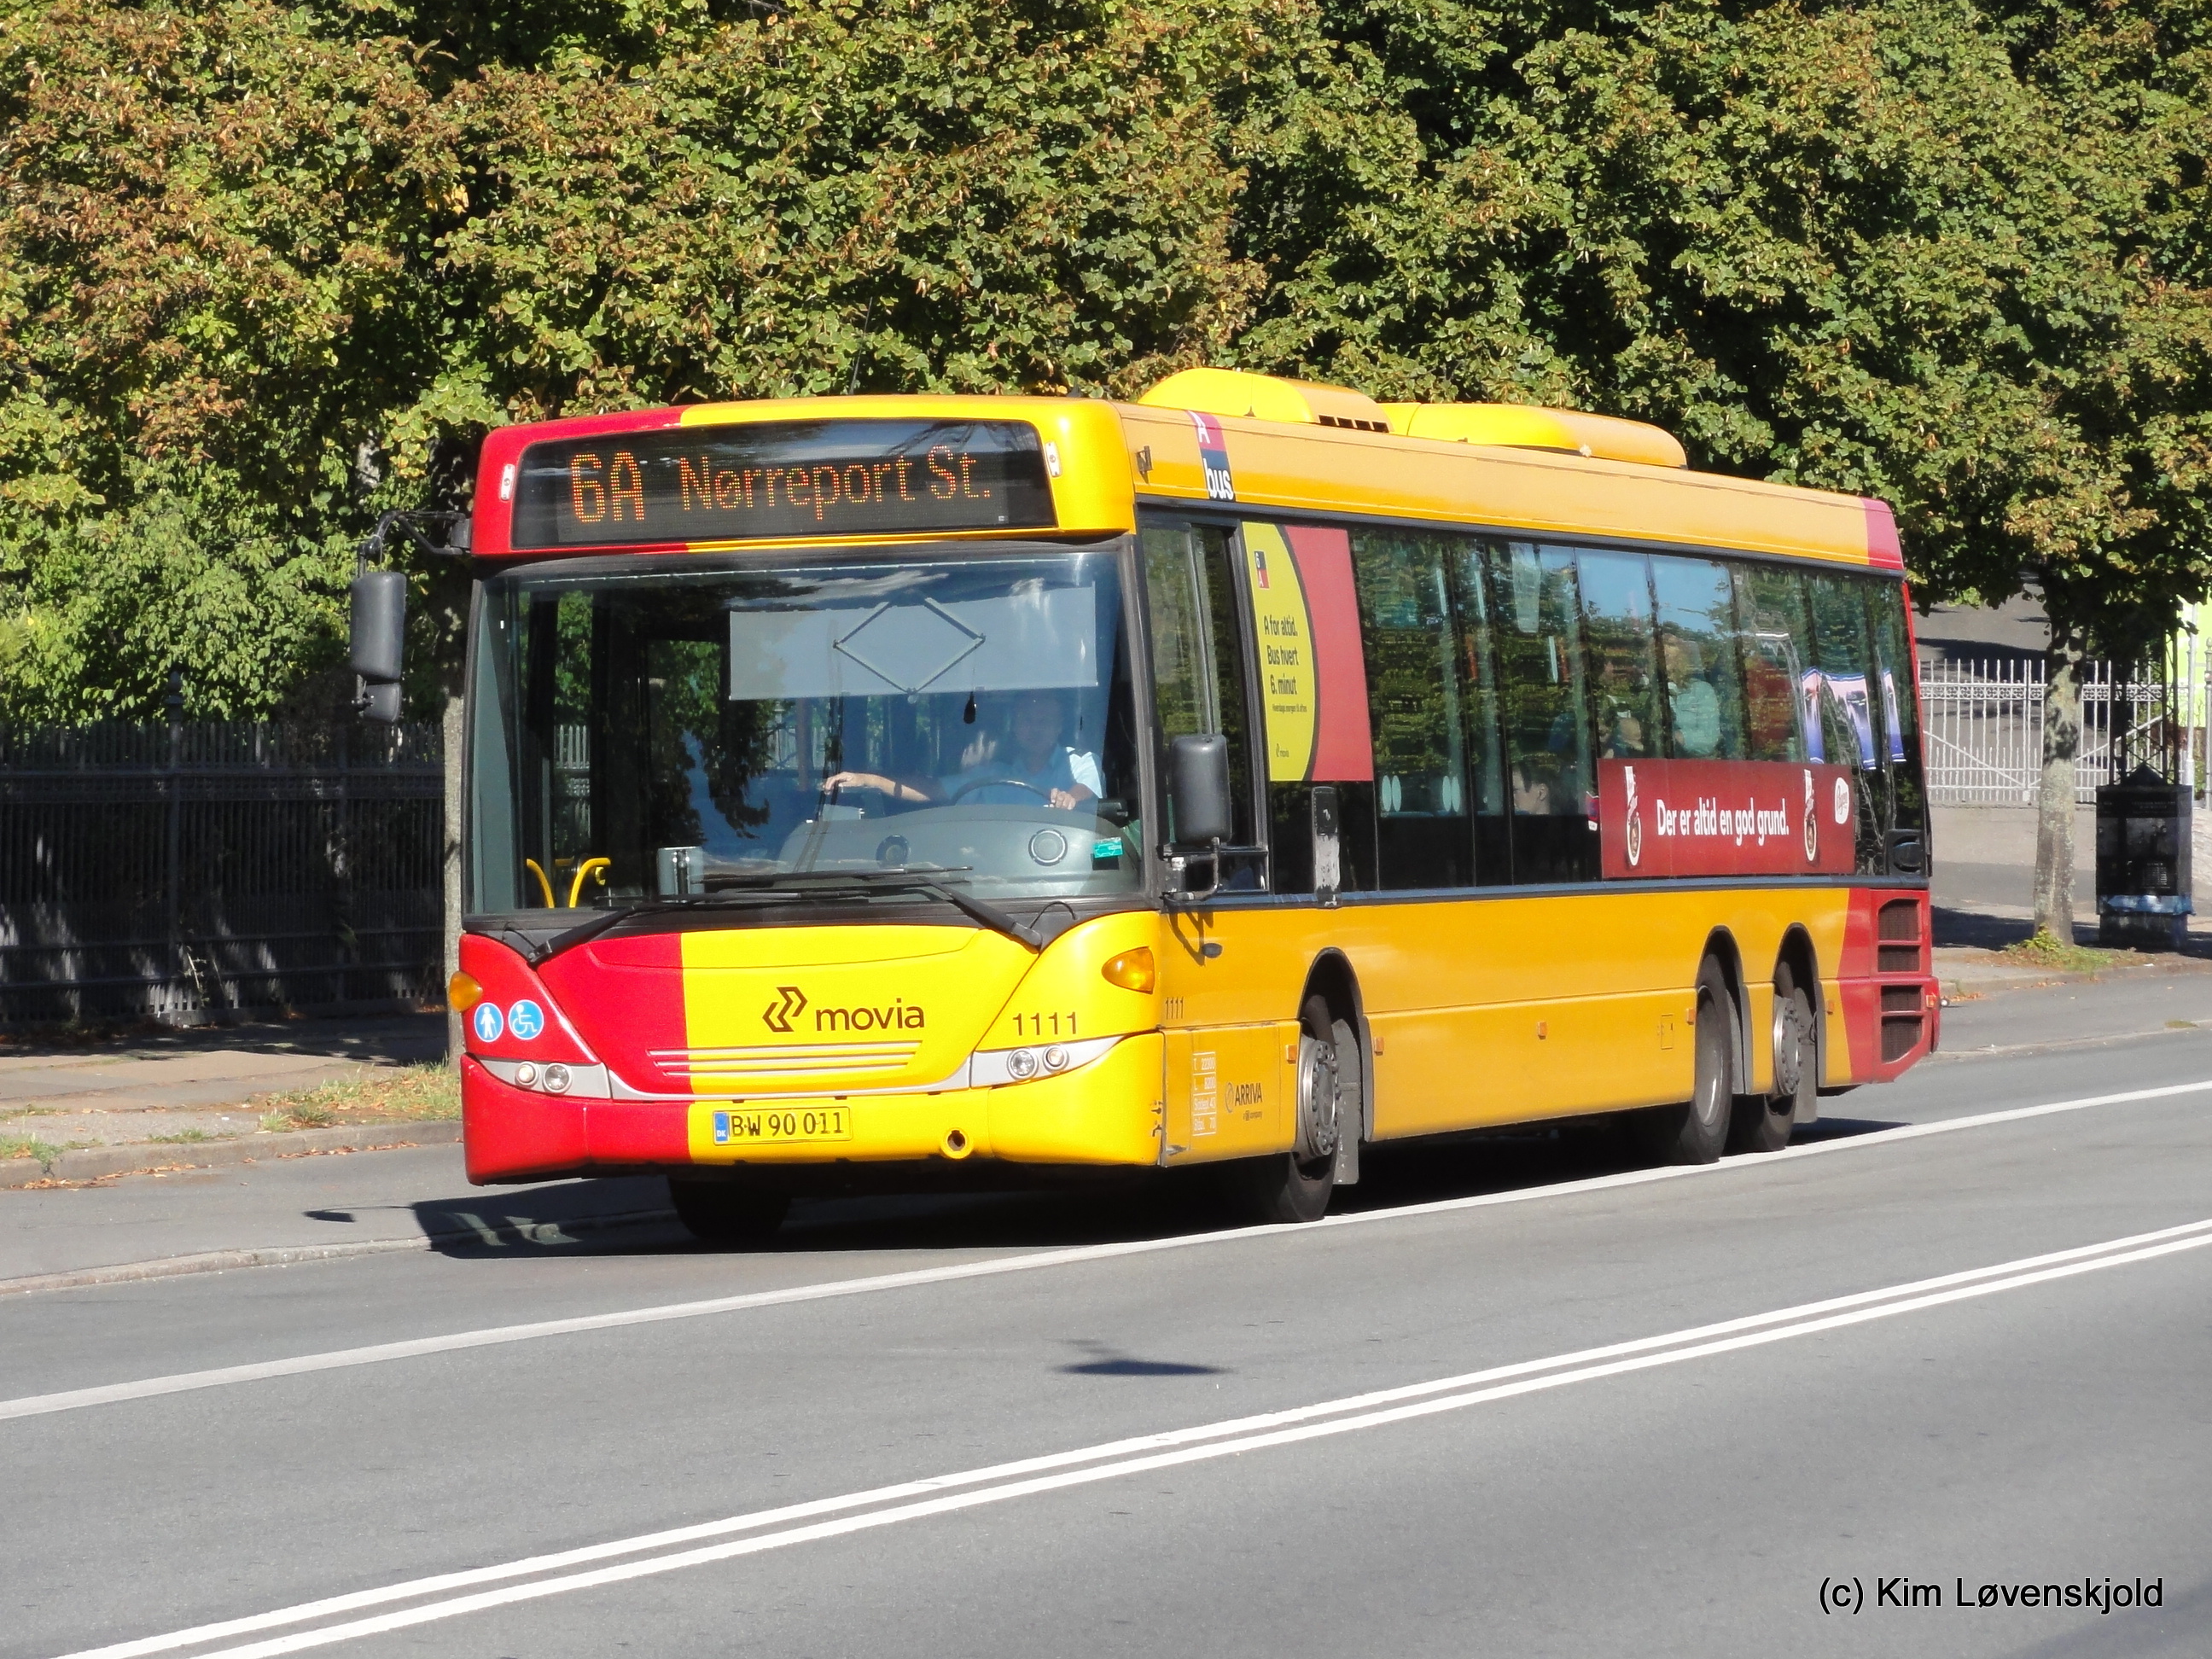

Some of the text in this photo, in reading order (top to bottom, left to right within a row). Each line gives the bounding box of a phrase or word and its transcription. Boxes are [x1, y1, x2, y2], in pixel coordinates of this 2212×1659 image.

[569, 444, 991, 523] 6A Nørreport St.
[1202, 457, 1234, 500] bus
[1264, 614, 1298, 637] A for altid.
[1266, 644, 1299, 666] Bus hvert
[1270, 672, 1298, 696] 6. minut
[1656, 796, 1790, 847] Der er altid en god grund.
[815, 997, 925, 1032] movia
[1165, 996, 1184, 1020] 1111
[1012, 1010, 1078, 1037] 1111
[1234, 1082, 1263, 1107] ARRIVA
[716, 1129, 726, 1138] DK
[731, 1112, 844, 1137] BW 90 011
